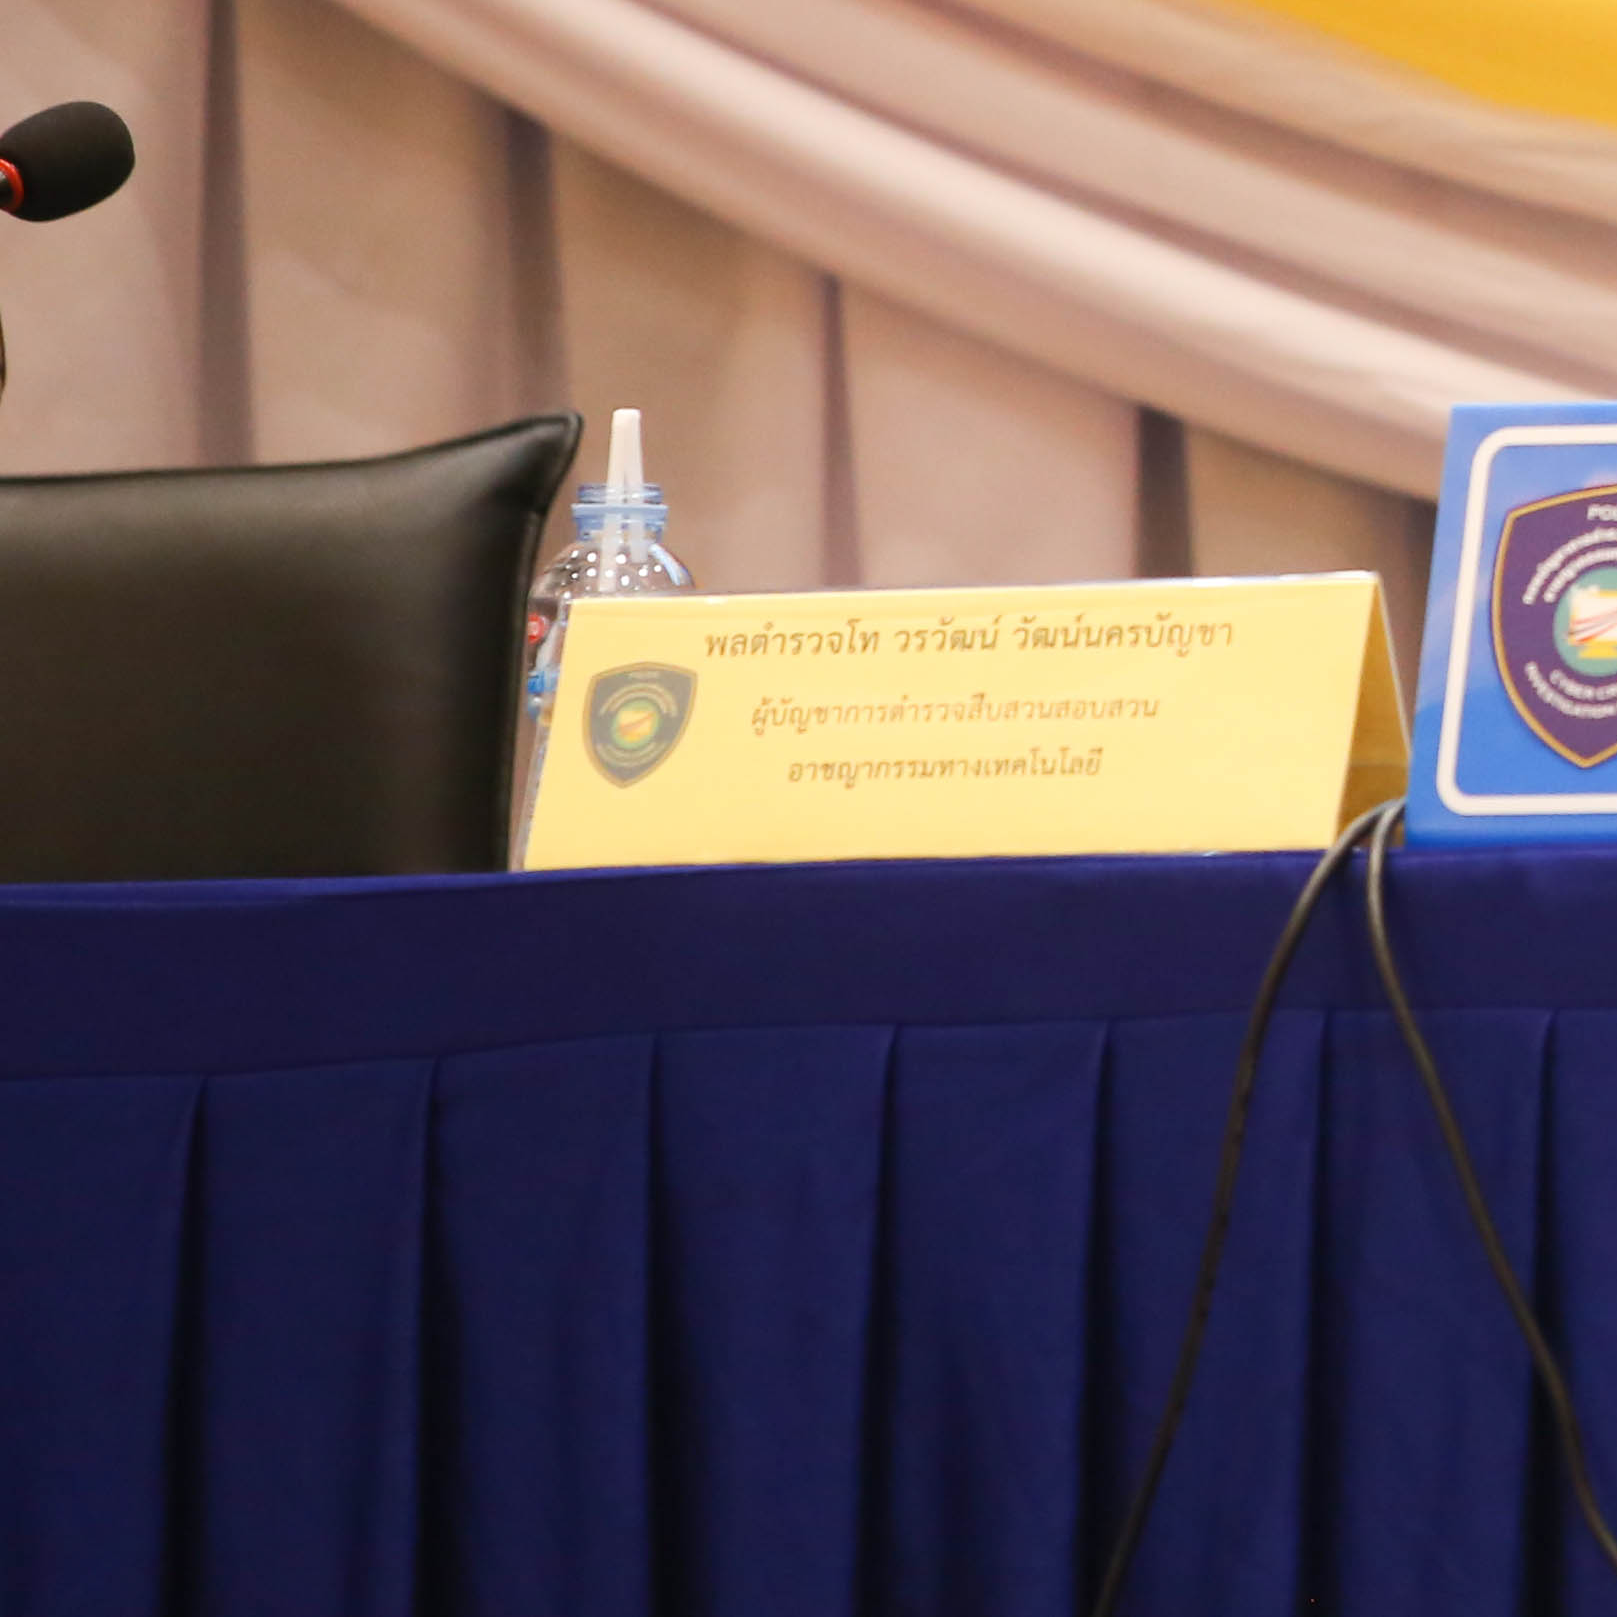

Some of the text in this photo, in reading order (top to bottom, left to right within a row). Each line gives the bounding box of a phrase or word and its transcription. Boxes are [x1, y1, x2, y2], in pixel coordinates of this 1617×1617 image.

[704, 611, 1234, 658] พลตำรวจโท วรวัฒน์ วัฒน์นครบัญชา
[751, 692, 1161, 738] ผู้บัญชาการตำรวจสืบสวนสอบสวน
[788, 746, 1104, 790] อาชญากรรมทางเทคโนโลยี
